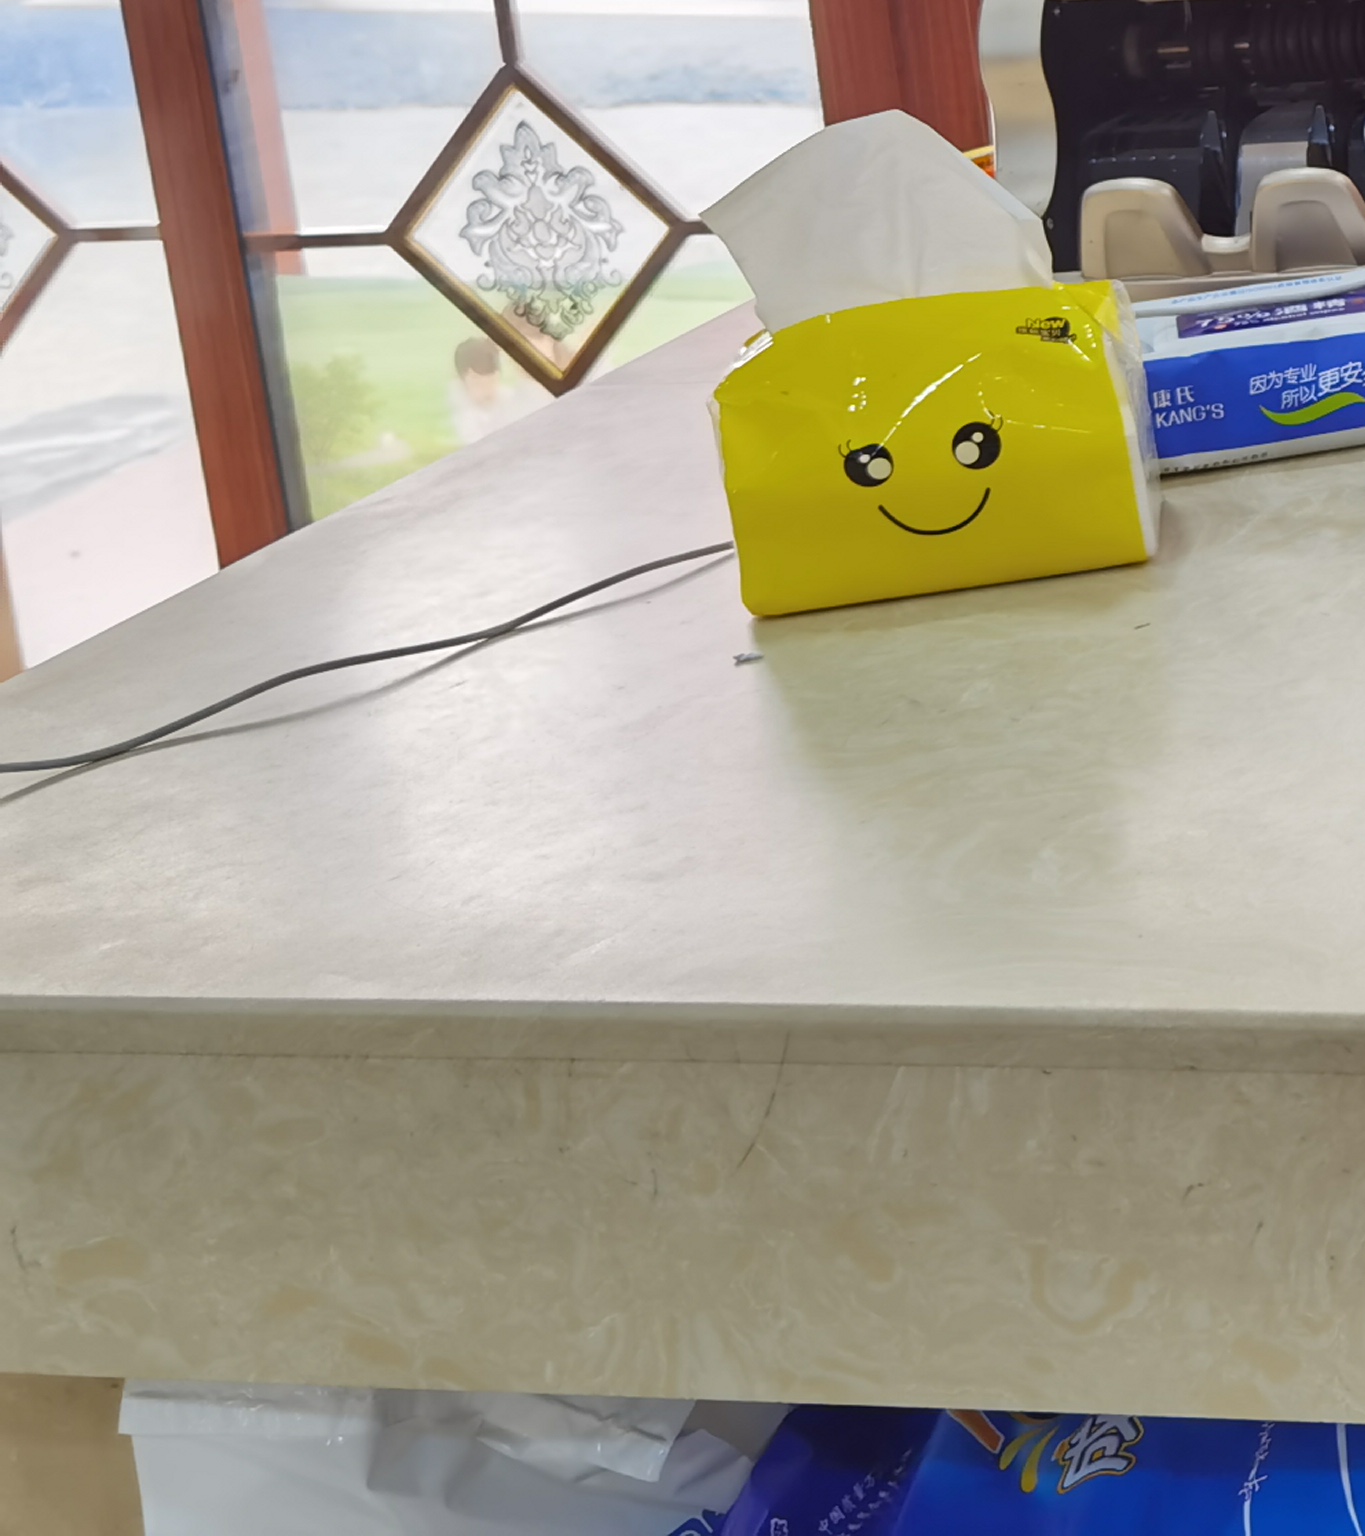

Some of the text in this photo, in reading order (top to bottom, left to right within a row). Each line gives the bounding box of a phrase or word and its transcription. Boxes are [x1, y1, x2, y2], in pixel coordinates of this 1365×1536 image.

[1248, 362, 1318, 396] 因为专业
[1152, 384, 1195, 410] 康氏
[1155, 402, 1226, 429] KANG'S
